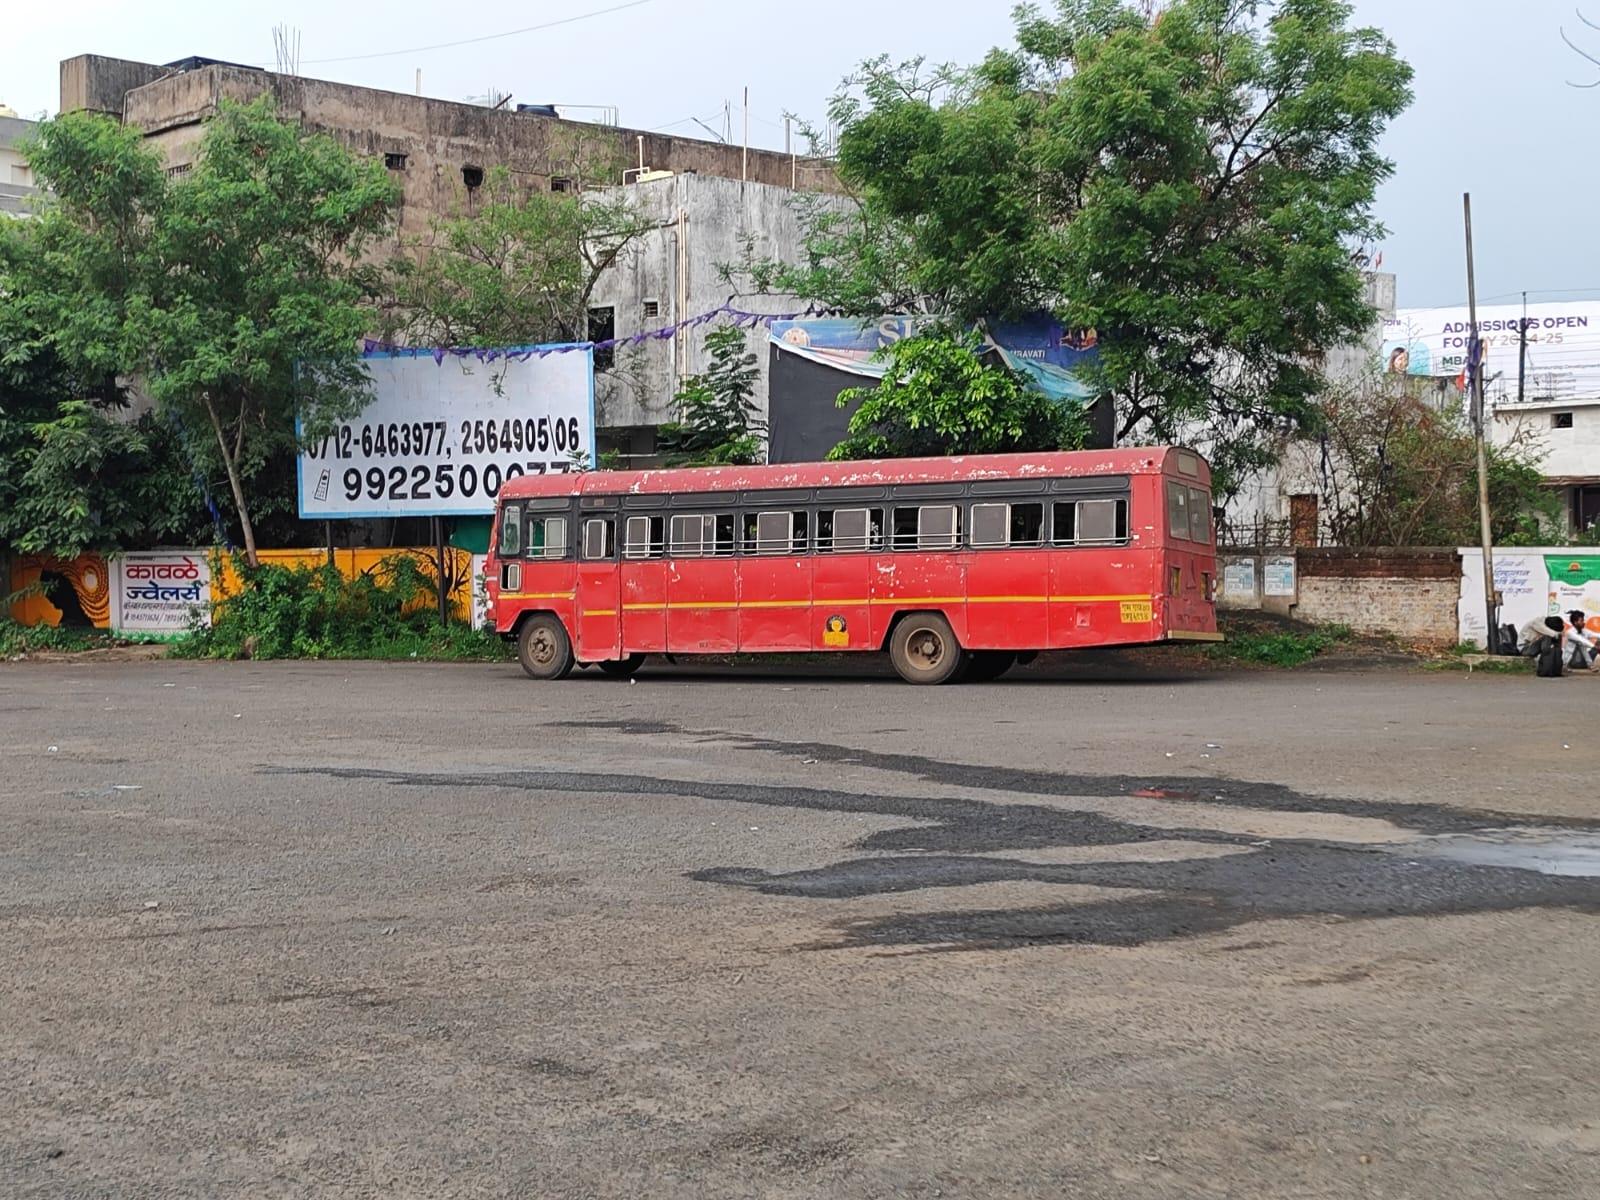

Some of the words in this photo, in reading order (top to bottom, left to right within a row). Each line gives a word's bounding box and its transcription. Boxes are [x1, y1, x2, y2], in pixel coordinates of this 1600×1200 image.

[1443, 318, 1540, 333] ADISSIOS
[1543, 316, 1588, 329] OPEN
[1500, 333, 1563, 346] 204-25
[461, 415, 580, 456] 2564905\06
[126, 556, 199, 579] कावळे
